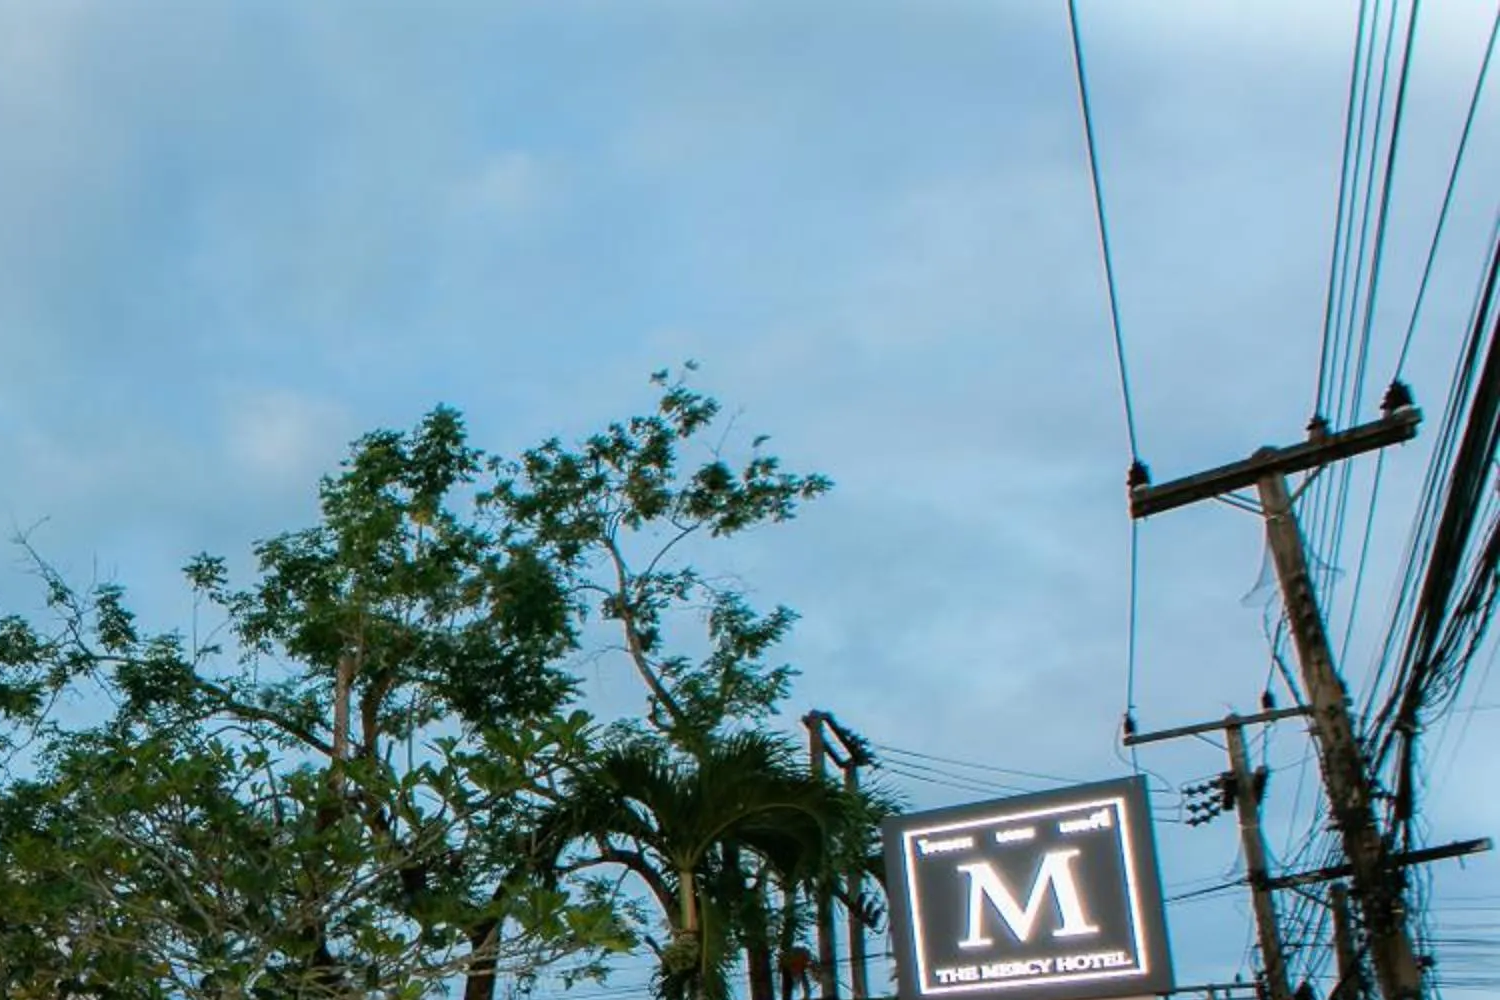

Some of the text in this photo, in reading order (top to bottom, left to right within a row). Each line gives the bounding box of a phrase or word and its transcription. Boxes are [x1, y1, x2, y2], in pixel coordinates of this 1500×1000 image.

[957, 849, 1100, 949] M
[936, 951, 1134, 984] THE MERCY HOTEL
